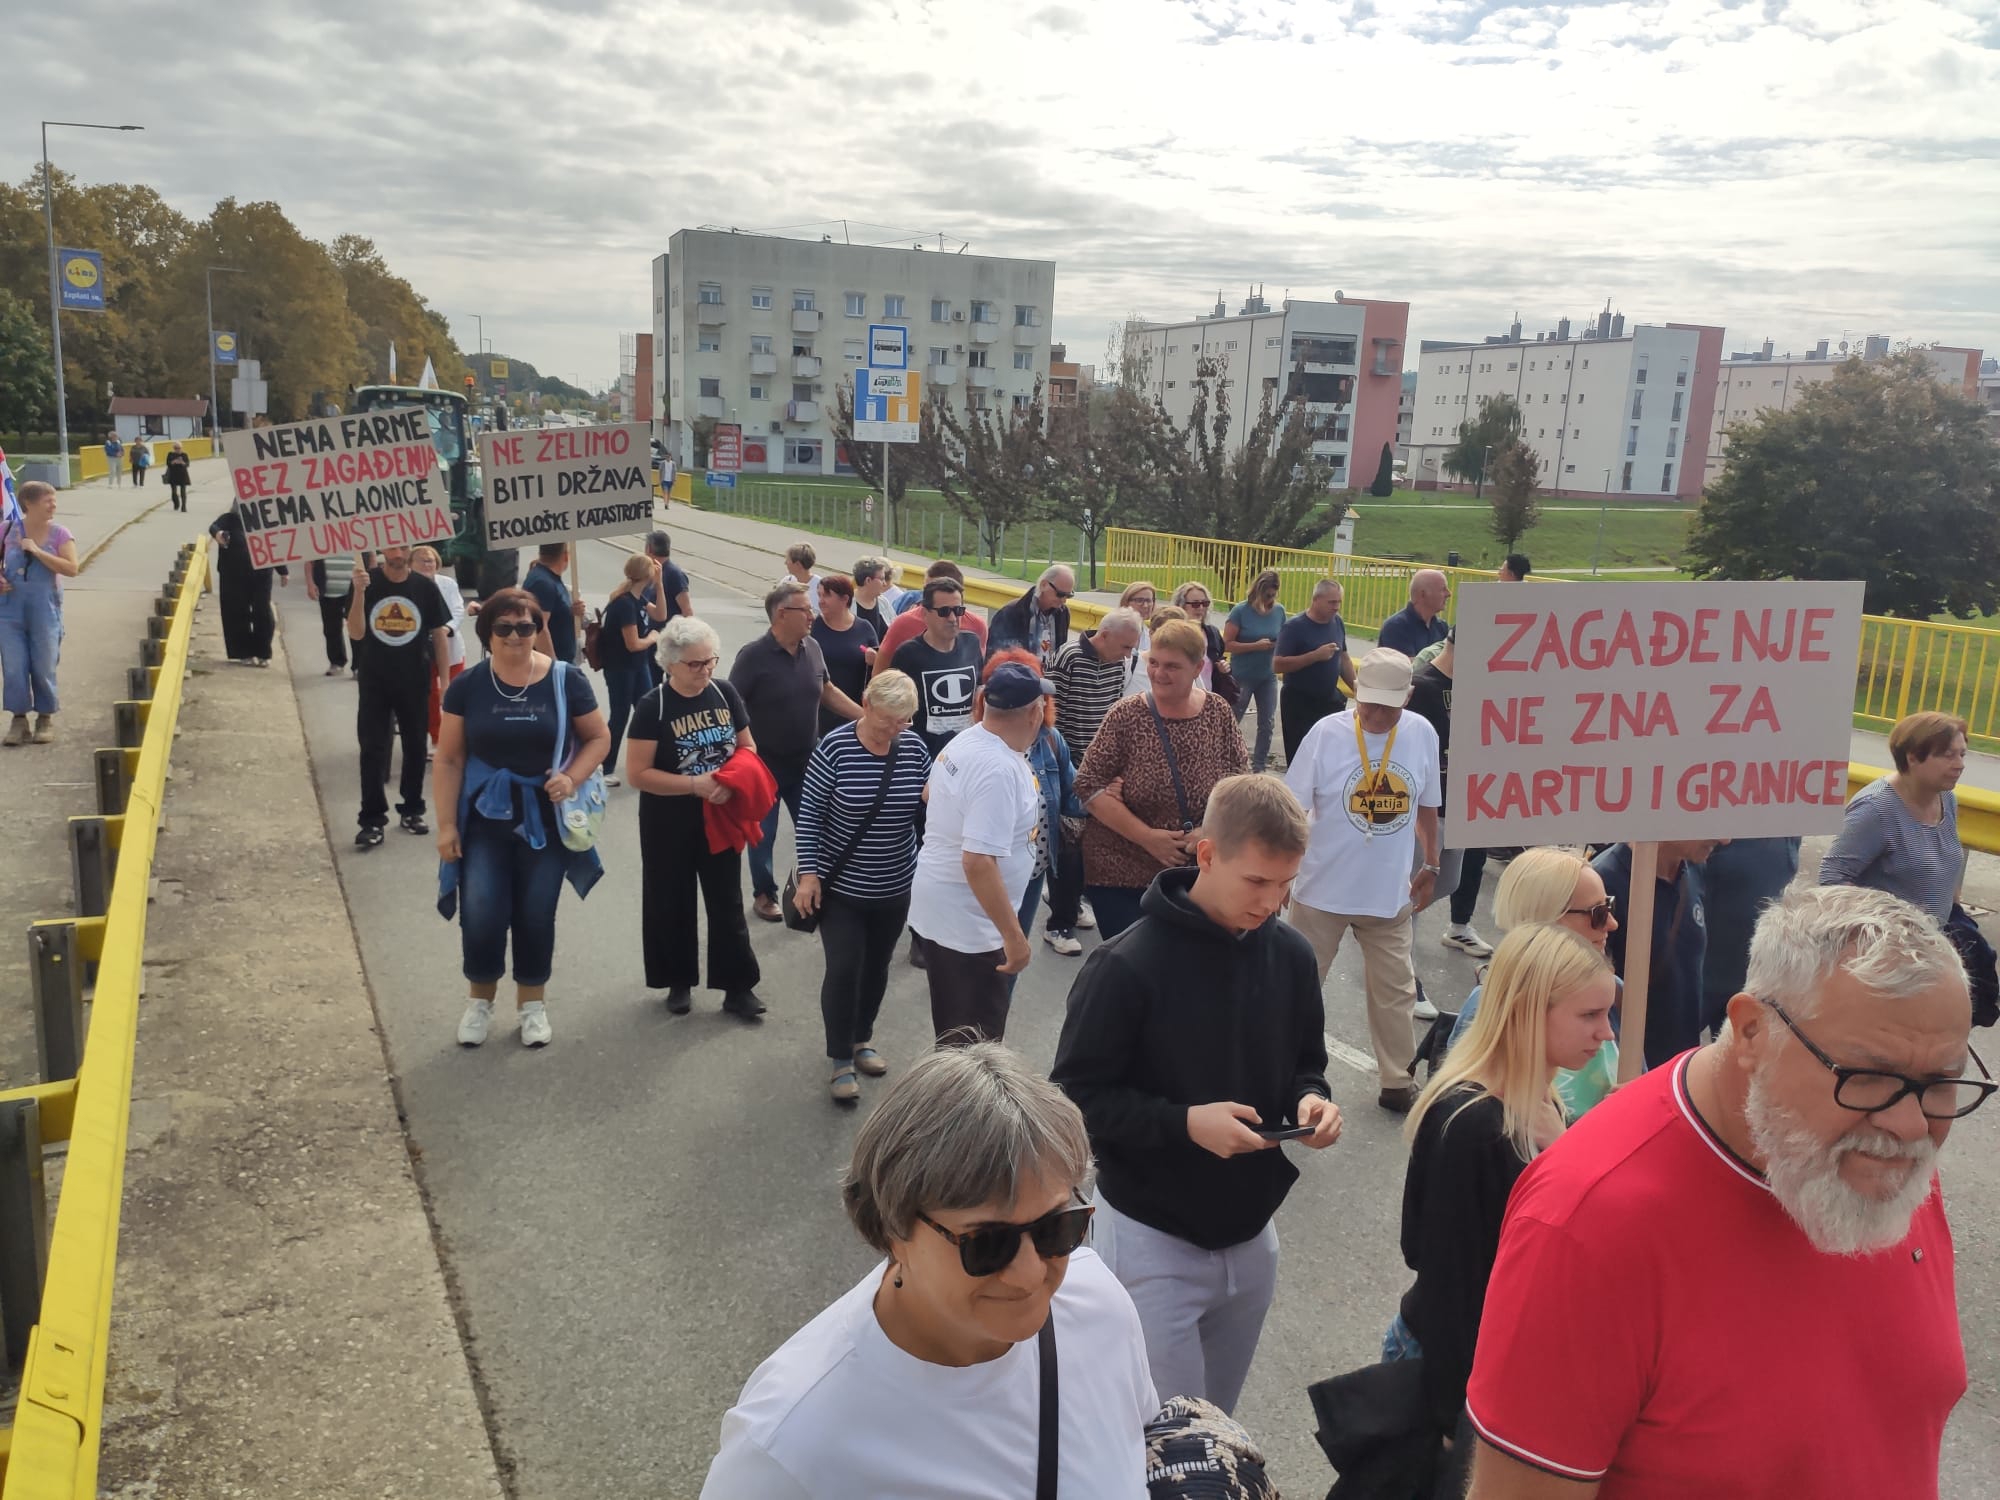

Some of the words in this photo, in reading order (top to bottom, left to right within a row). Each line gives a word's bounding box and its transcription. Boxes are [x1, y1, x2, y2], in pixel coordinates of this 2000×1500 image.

[253, 424, 335, 460] NEMA
[341, 410, 429, 448] FARME
[492, 437, 524, 466] NE
[536, 429, 630, 462] ŽELIMO
[234, 463, 292, 499] BEZ
[301, 444, 440, 490] ZAGAĐENJA
[493, 474, 544, 504] BITI
[558, 464, 646, 496] DRŽAVA
[239, 495, 316, 533] NEMA
[321, 478, 432, 520] KLAONICE
[489, 510, 570, 541] EKOLOŠKE
[577, 500, 653, 529] KATASTROFE
[248, 528, 302, 567] BEZ
[309, 507, 452, 555] UNIŠTENJA
[1487, 607, 1834, 673] ZAGAĐENJE
[670, 710, 715, 738] WAKE
[714, 708, 731, 726] UP
[698, 727, 722, 746] AND
[1480, 696, 1544, 746] NE
[1570, 691, 1679, 745] ZNA
[1705, 684, 1781, 735] ZA
[1467, 765, 1632, 822] KARTU
[1650, 765, 1664, 811] I
[1676, 760, 1849, 813] GRANICE
